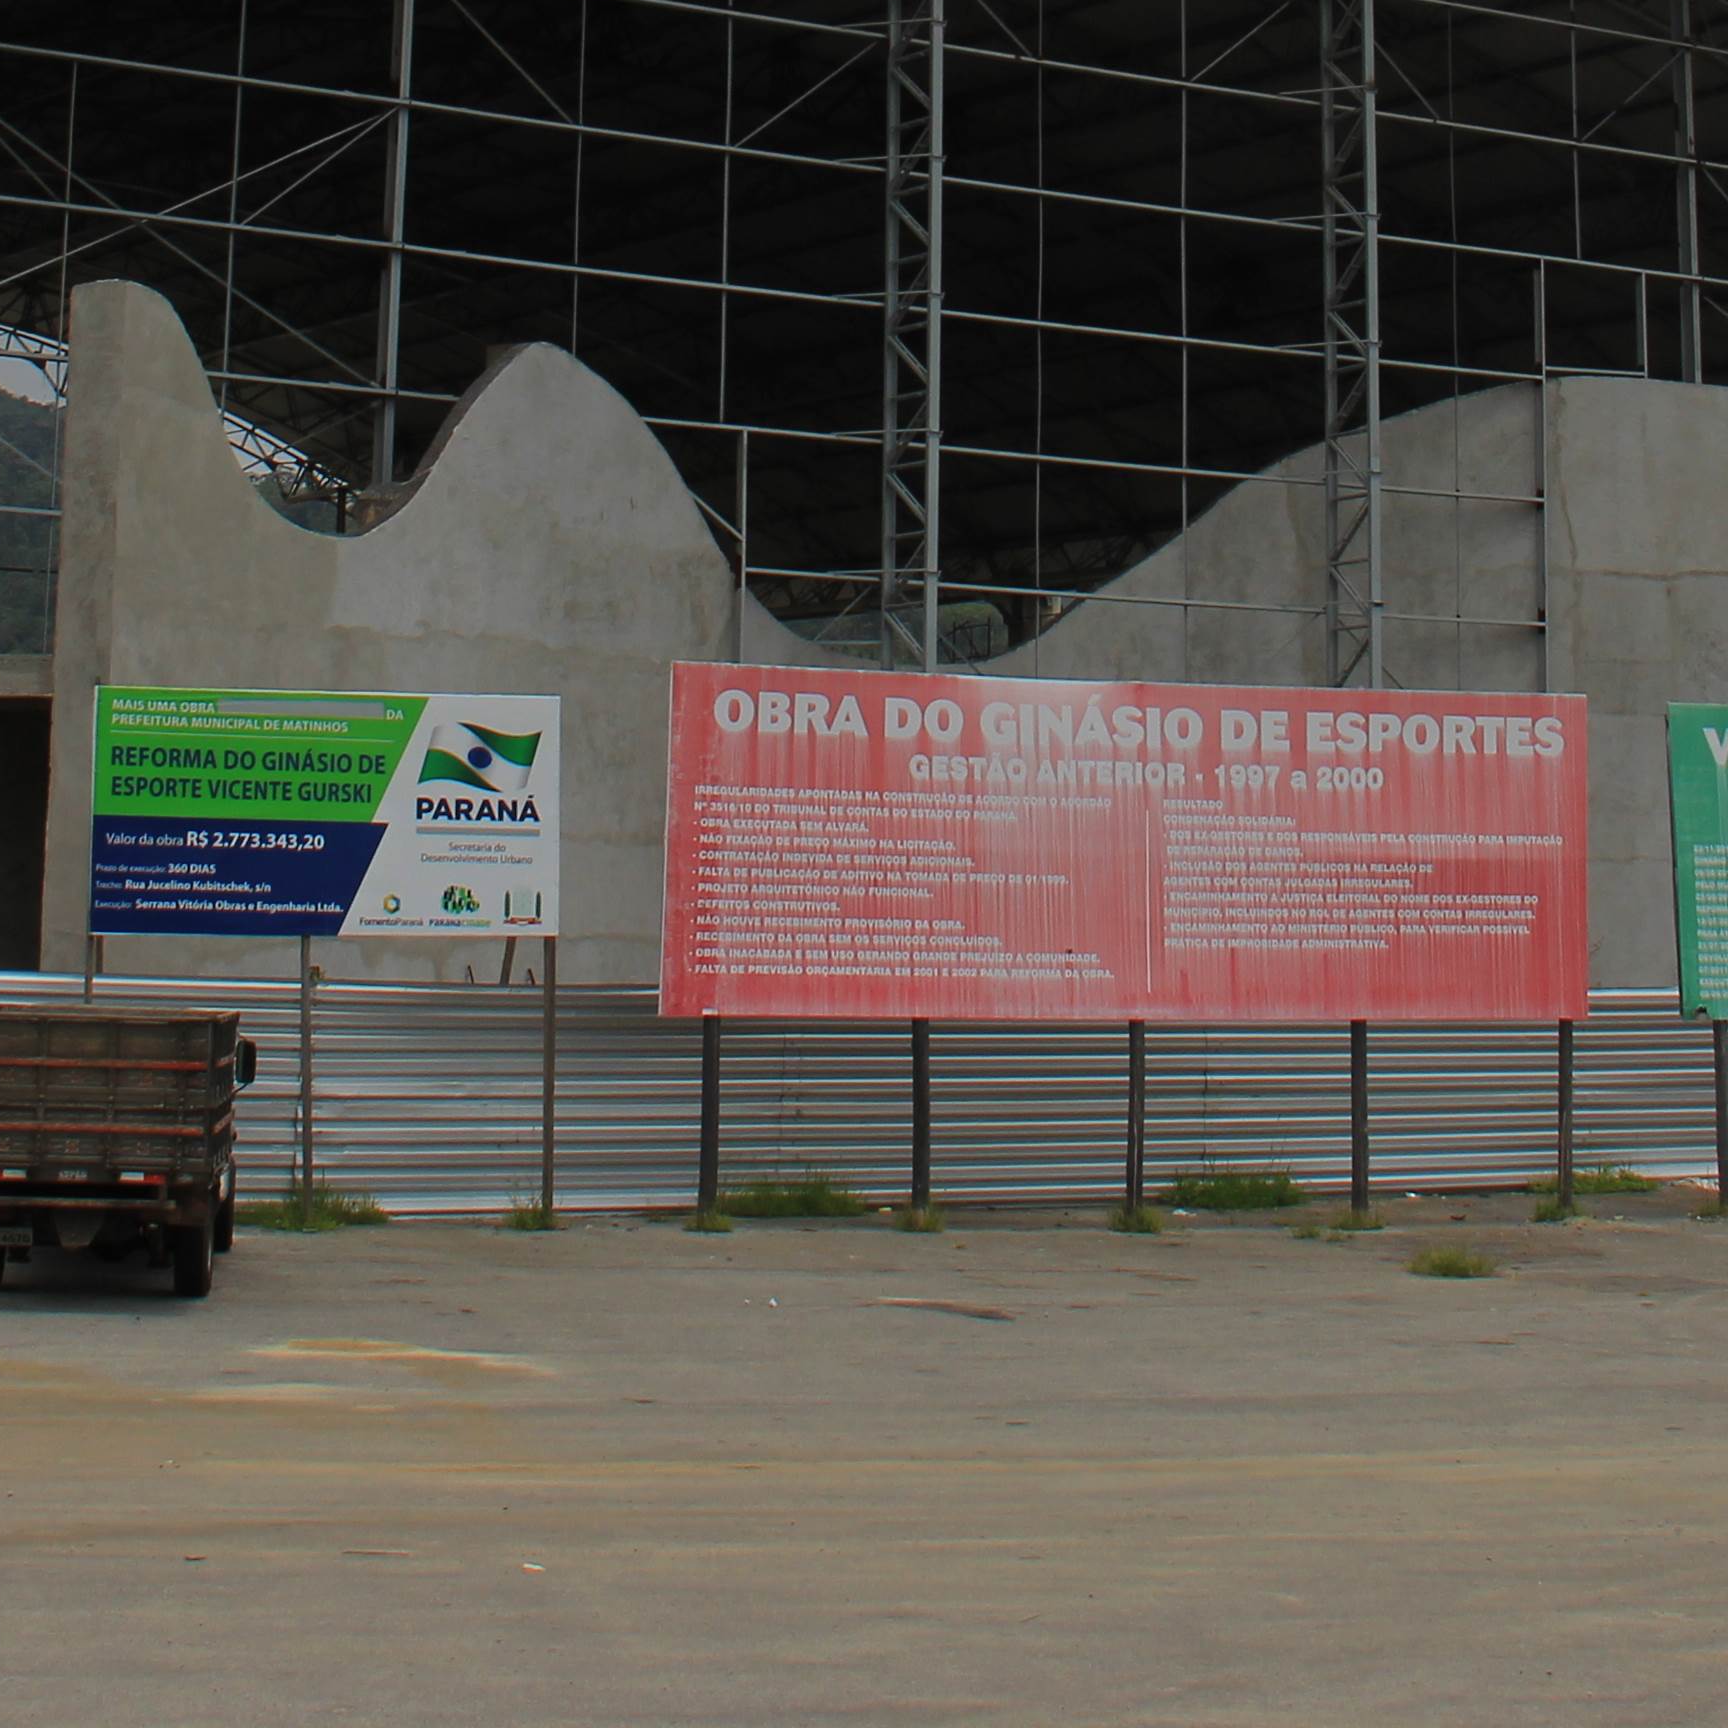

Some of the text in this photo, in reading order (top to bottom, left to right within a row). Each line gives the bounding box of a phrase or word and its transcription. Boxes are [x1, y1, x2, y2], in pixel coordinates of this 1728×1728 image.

[113, 699, 403, 720] MAIS UMA OBRA DA
[112, 714, 348, 732] PREFEITURA MUNICIPAL DE MATINHOS
[714, 688, 1565, 758] OBRA DO GINÁSIO DE ESPORTES
[111, 746, 385, 773] REFORMA DO GINÁSIO DE
[910, 752, 1025, 783] GESTÃO
[1036, 761, 1185, 786] ANTERIOR
[1214, 764, 1280, 788] 1997
[1291, 770, 1307, 789] a
[1317, 766, 1383, 790] 2000
[111, 776, 371, 803] ESPORTE VICENTE GURSKI
[417, 795, 540, 822] PARANÁ
[701, 819, 869, 832] OBRA EXECUTADA SEM ALVARÁ.
[106, 831, 324, 851] Valor da obra R$ 2.773.343,20
[449, 842, 506, 852] Secretaria do
[700, 834, 955, 850] NÃO FIXAÇÃO DE PREÇO MÁXIMO NA LICITAÇÃO.
[421, 854, 532, 864] Desenvolvimento Urbano
[699, 850, 974, 866] CONTRATAÇÃO INDEVIDA DE SERVIÇOS ADICIONAIS.
[168, 864, 188, 873] 360
[189, 864, 216, 874] DIAS
[699, 867, 729, 877] FALTA
[733, 868, 748, 876] DE
[751, 868, 819, 880] PUBLICAÇÃO
[823, 870, 837, 879] DE
[841, 870, 883, 881] ADITIVO
[887, 872, 901, 881] NA
[905, 872, 949, 881] TOMADA
[953, 873, 966, 882] DE
[970, 874, 1005, 883] PREÇO
[1009, 874, 1022, 883] DE
[125, 880, 145, 889] Rua
[147, 880, 190, 891] Jucelino
[193, 881, 252, 892] Kubitschek,
[256, 883, 271, 892] s/n
[698, 884, 933, 897] PROJETO ARQUITETÔNICO NÃO FUNCIONAL.
[136, 899, 176, 909] Serrana
[178, 900, 213, 910] Vitória
[215, 901, 246, 911] Obras
[256, 901, 315, 914] Engenharia
[318, 903, 344, 912] Ltda.
[698, 901, 840, 911] DEFEITOS CONSTRUTIVOS.
[697, 915, 965, 929] NÃO HOUVE RECEBIMENTO PROVISÓRIO DA OBRA.
[697, 933, 1002, 947] RECEBIMENTO DA OBRA SEM OS SERVIÇOS CONCLUÍDOS.
[696, 949, 725, 957] OBRA
[729, 949, 792, 959] INACABADA
[806, 951, 828, 960] SEM
[832, 951, 853, 960] USO
[857, 952, 909, 961] GERANDO
[913, 952, 957, 961] GRANDE
[1026, 953, 1099, 963] COMUNIDADE.
